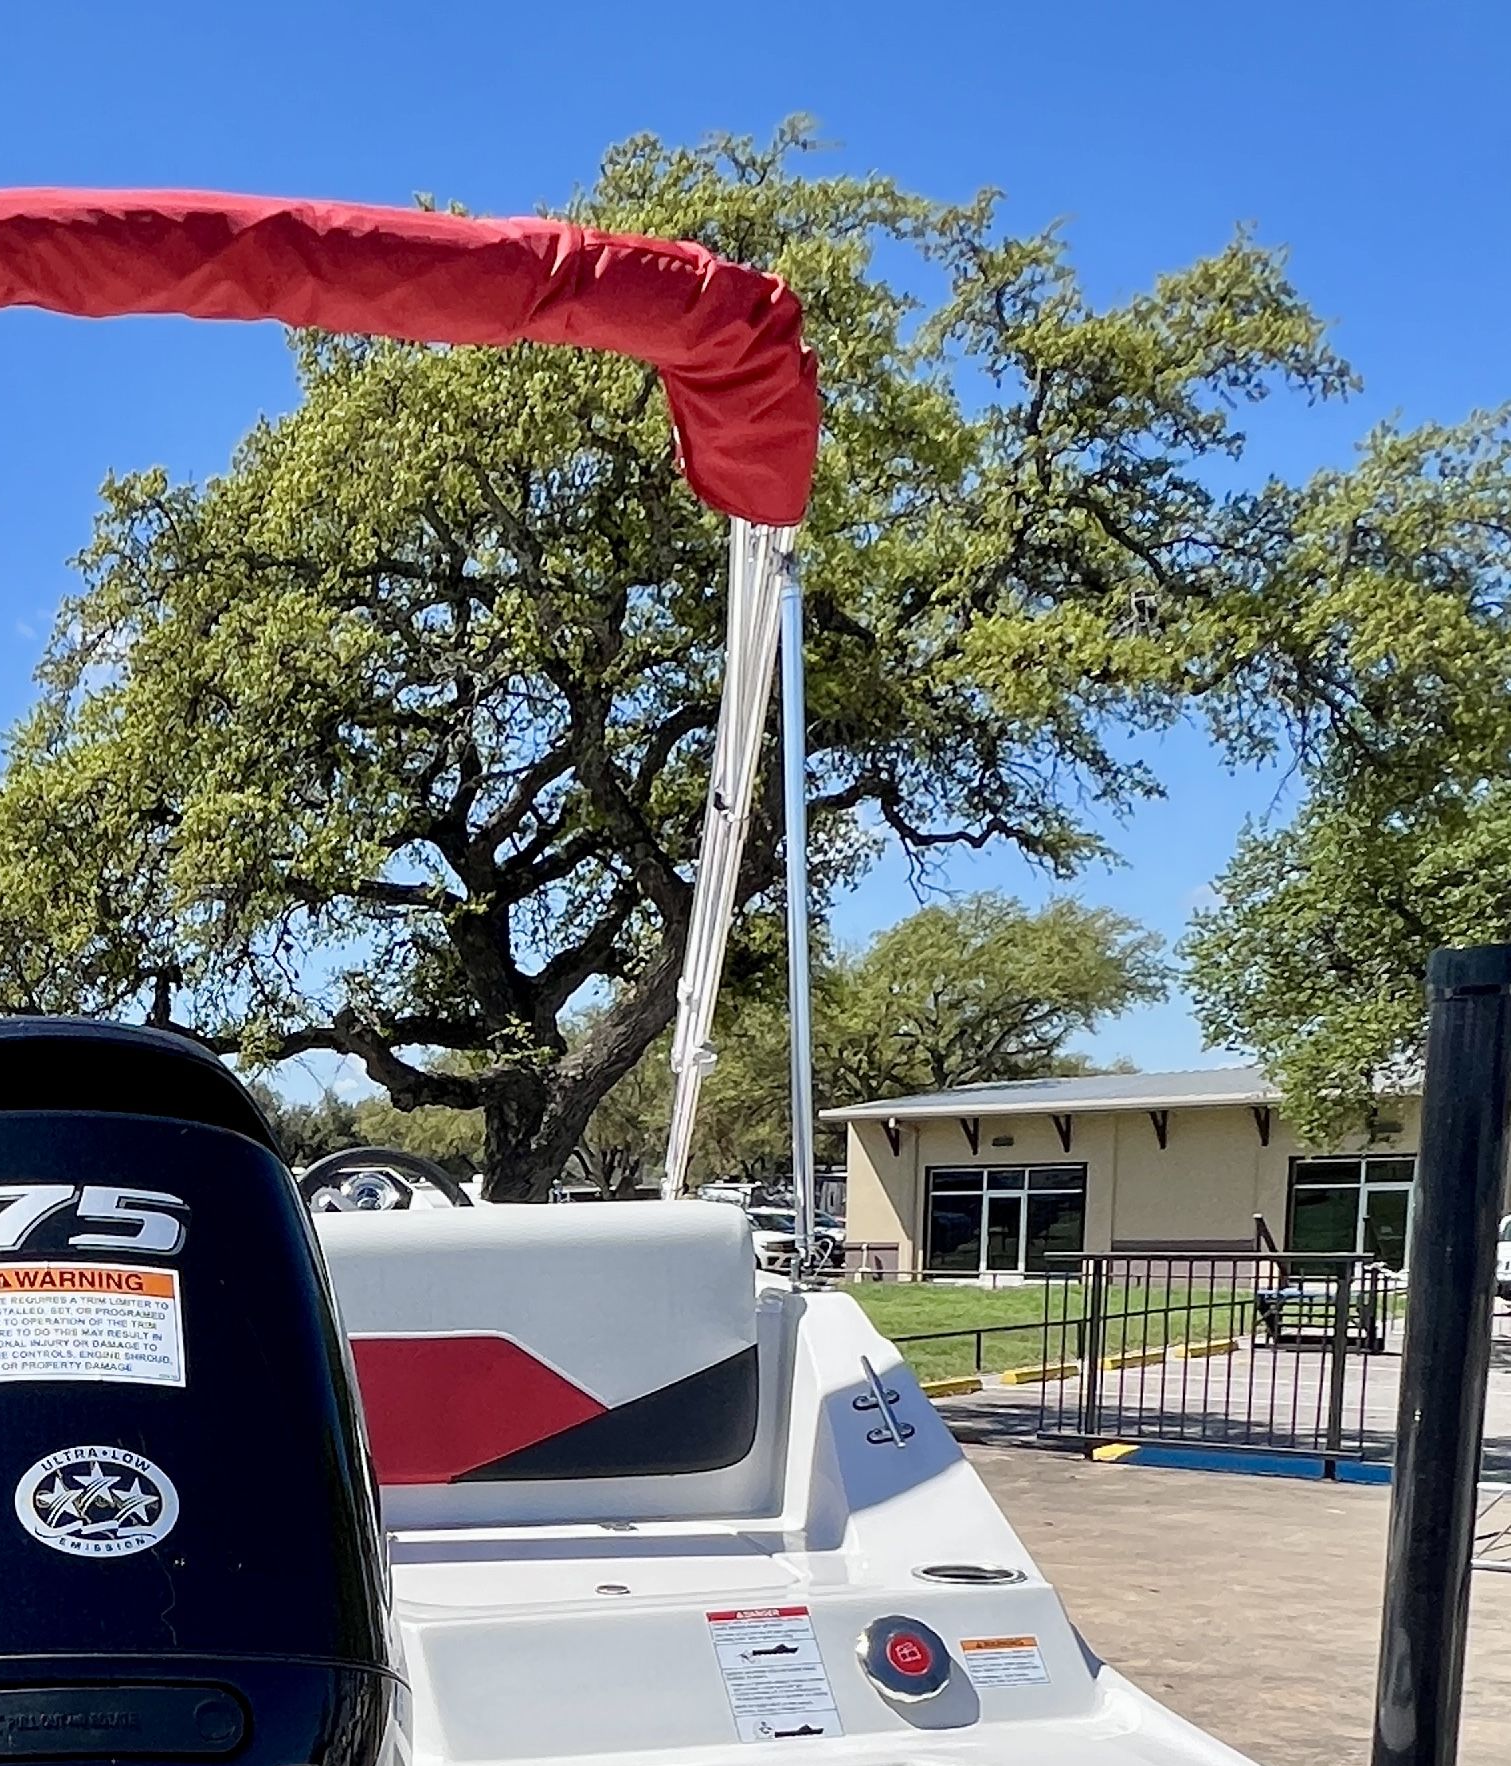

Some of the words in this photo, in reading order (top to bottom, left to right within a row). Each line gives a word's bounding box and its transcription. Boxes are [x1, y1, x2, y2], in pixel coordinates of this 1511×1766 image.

[15, 1271, 144, 1291] WARNING
[10, 1296, 67, 1305] REQUIRES
[80, 1297, 106, 1305] TRIM
[109, 1297, 152, 1308] LIMITER
[154, 1301, 169, 1310] TO
[76, 1307, 92, 1315] OR
[4, 1318, 18, 1326] TO
[21, 1317, 86, 1326] OPERATION
[88, 1317, 103, 1326] OF
[107, 1319, 128, 1328] THE
[16, 1328, 31, 1337] TO
[34, 1328, 50, 1336] DO
[81, 1329, 104, 1337] MAY
[107, 1330, 149, 1340] RESULT
[152, 1333, 163, 1341] IN
[30, 1339, 70, 1347] INJURY
[73, 1339, 89, 1348] OR
[92, 1340, 140, 1350] DAMAGE
[143, 1343, 158, 1352] TO
[79, 1351, 120, 1359] ENGINE
[1, 1362, 18, 1371] OR
[21, 1361, 81, 1370] PROPERTY
[41, 1447, 98, 1472] ULTRA
[58, 1537, 146, 1552] EMISSION
